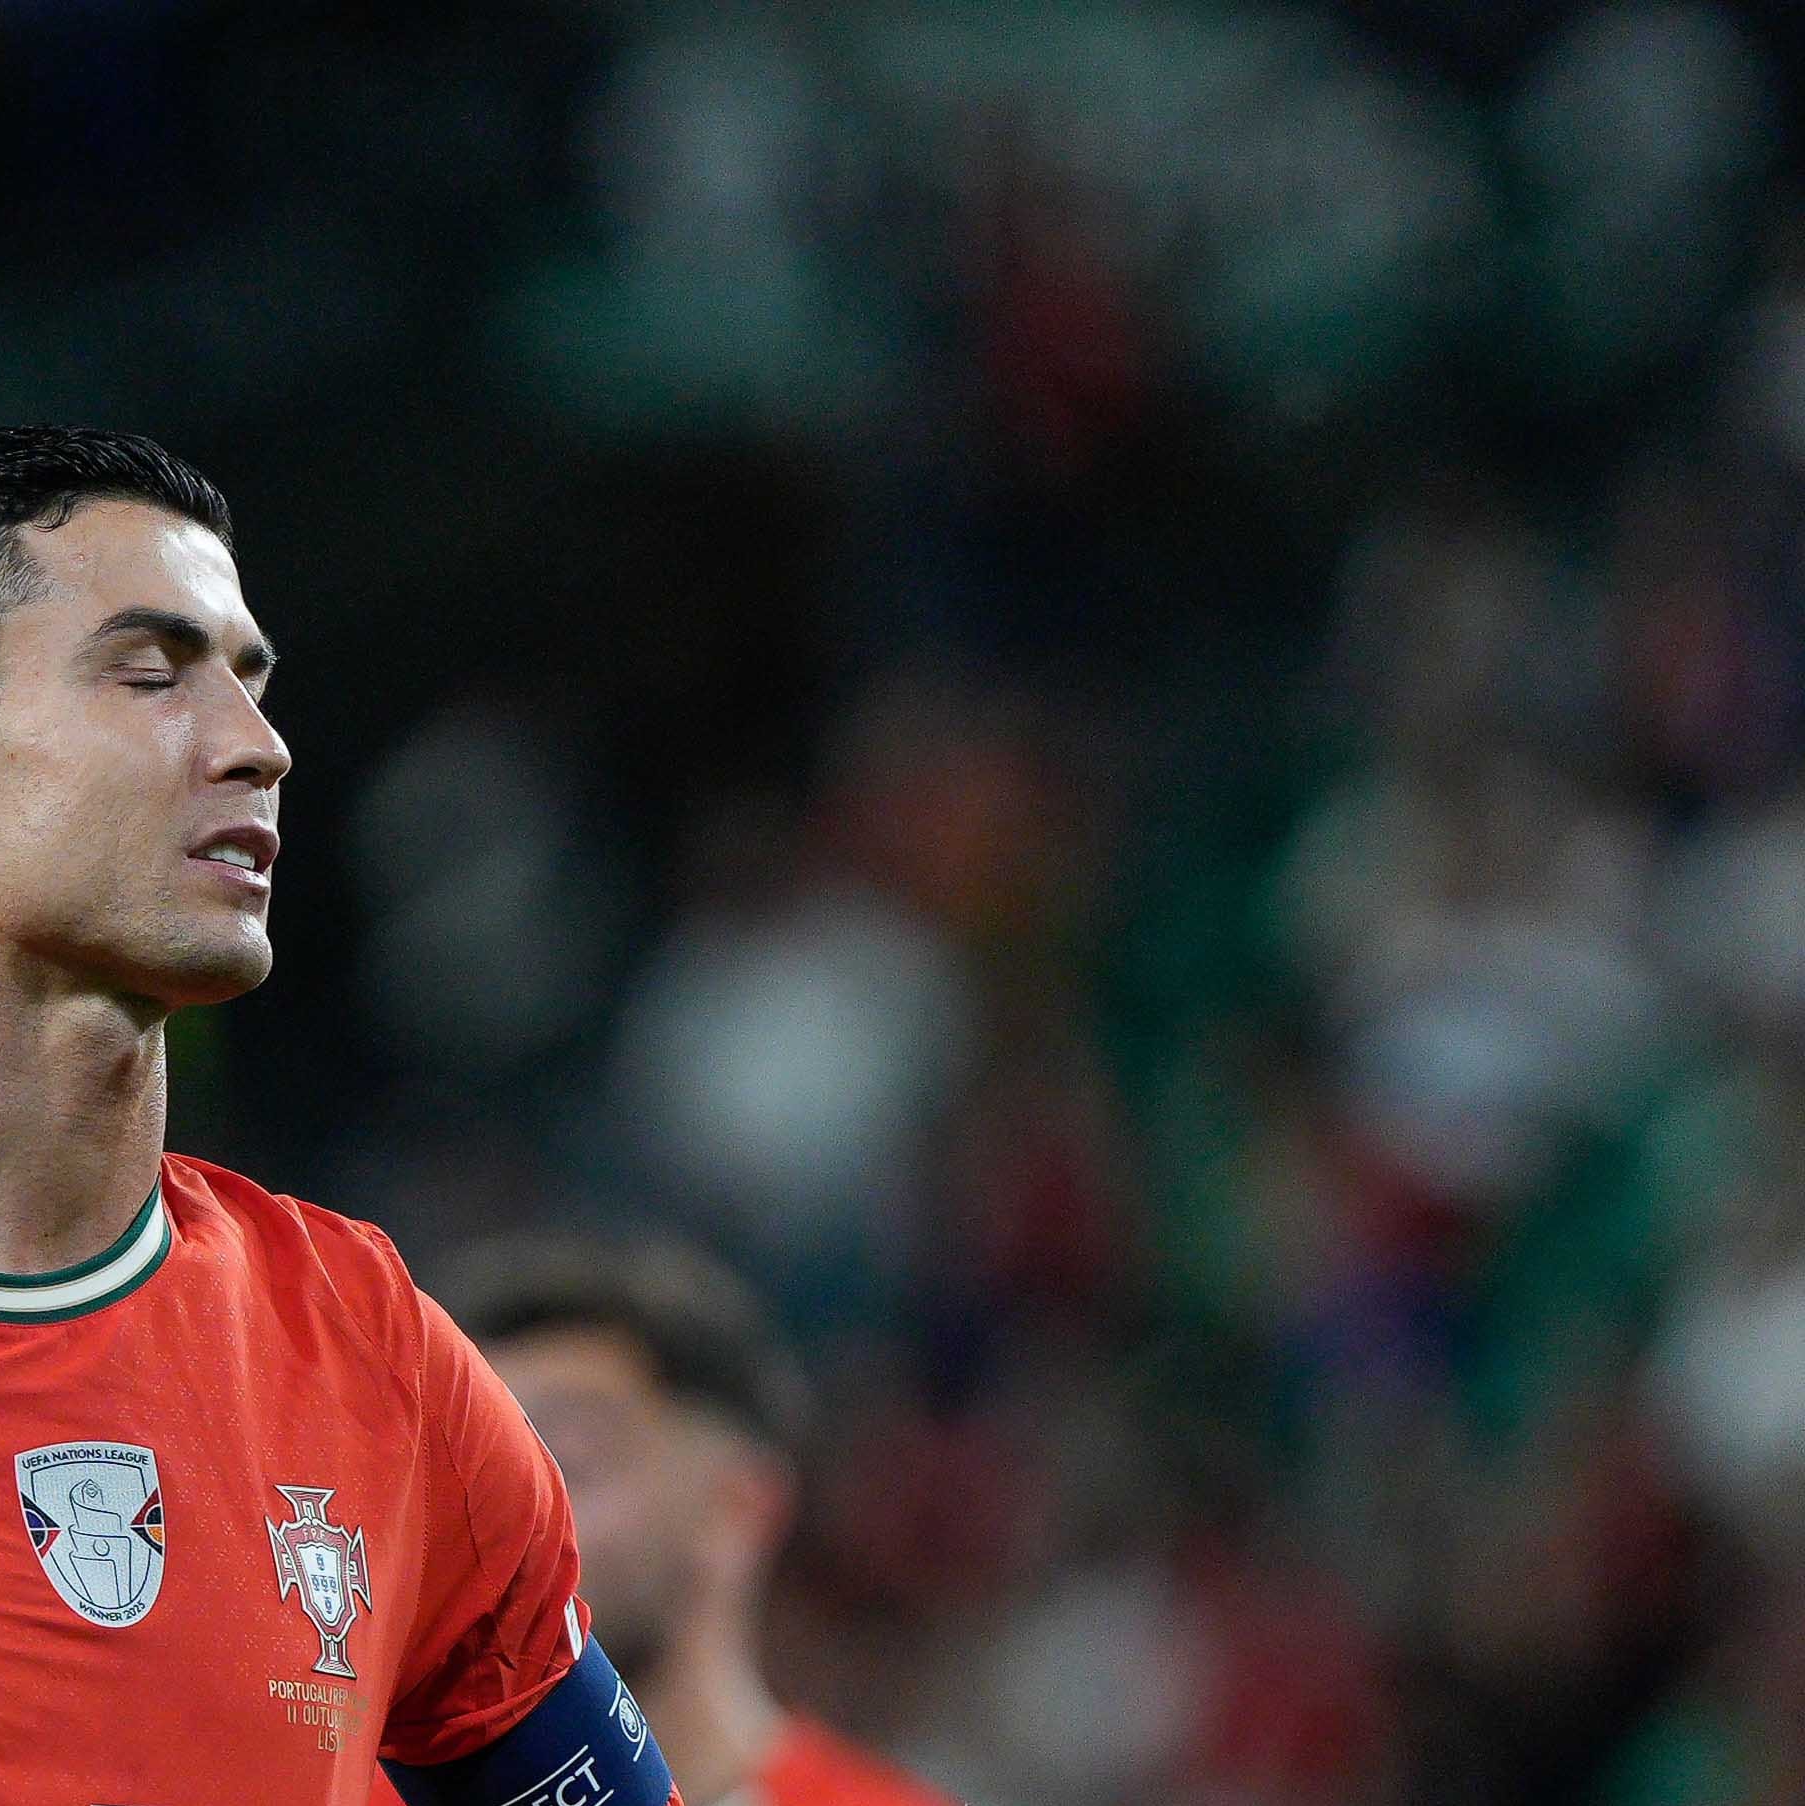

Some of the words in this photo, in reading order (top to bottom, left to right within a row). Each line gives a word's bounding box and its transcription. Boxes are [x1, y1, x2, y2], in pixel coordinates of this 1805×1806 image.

[22, 1455, 50, 1469] UEFA
[52, 1449, 101, 1462] NATIONS
[105, 1450, 149, 1465] LEAGUE
[79, 1601, 122, 1621] WINNER
[123, 1599, 145, 1619] 2025
